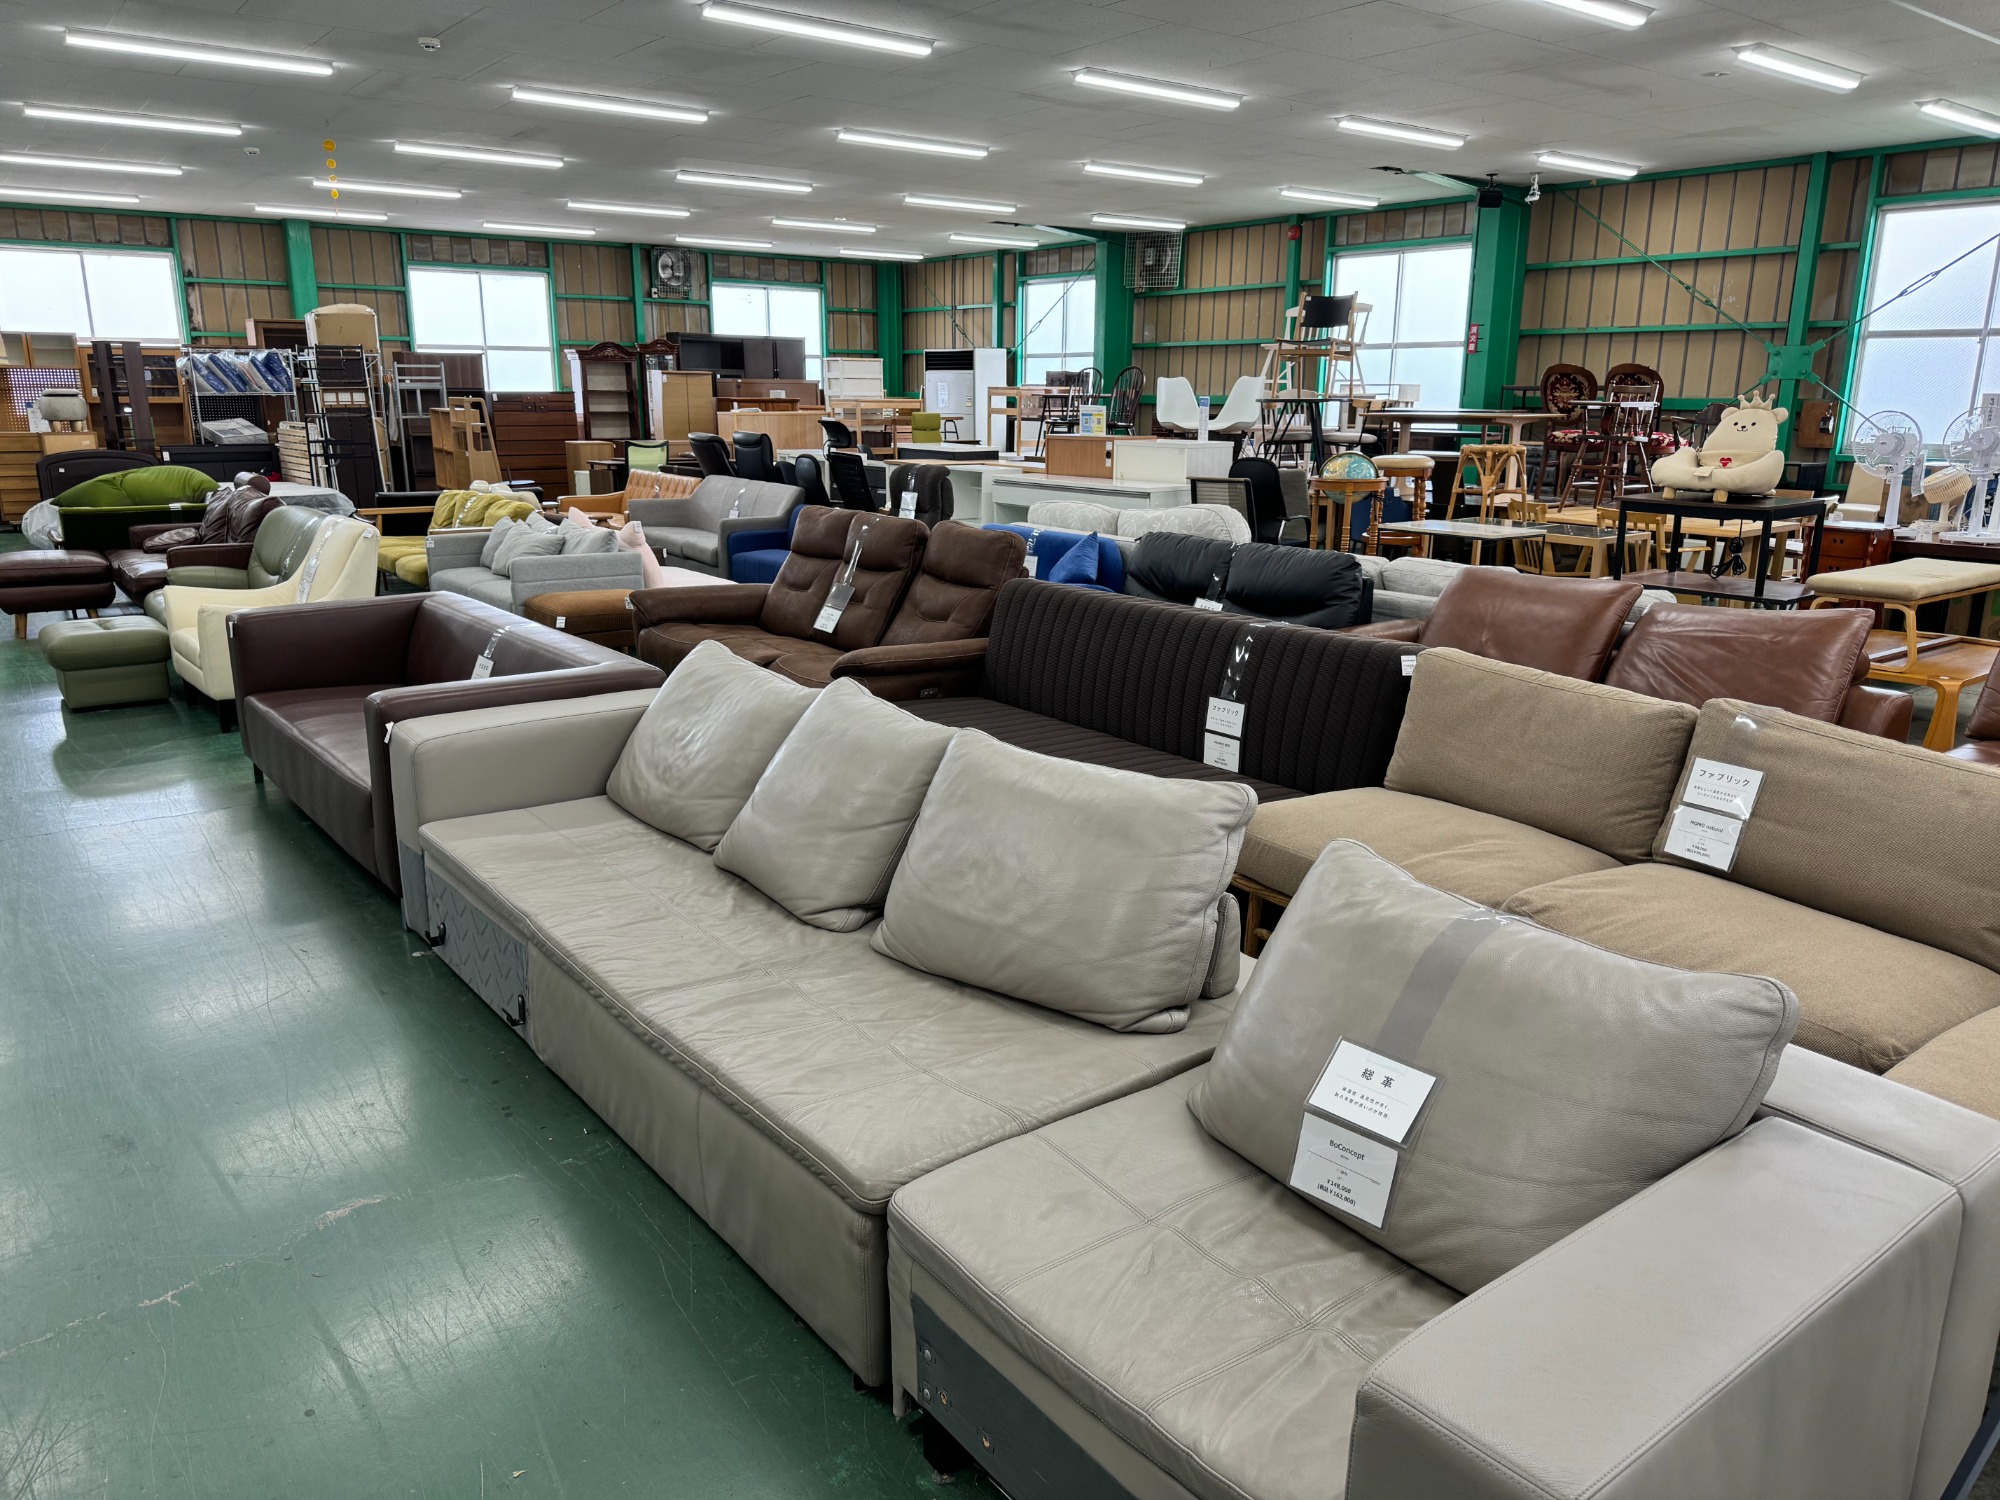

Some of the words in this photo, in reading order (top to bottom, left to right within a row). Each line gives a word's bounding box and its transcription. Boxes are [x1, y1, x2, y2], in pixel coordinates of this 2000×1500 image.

[1699, 769, 1750, 787] ファブリック
[1329, 1139, 1366, 1161] BoConcept
